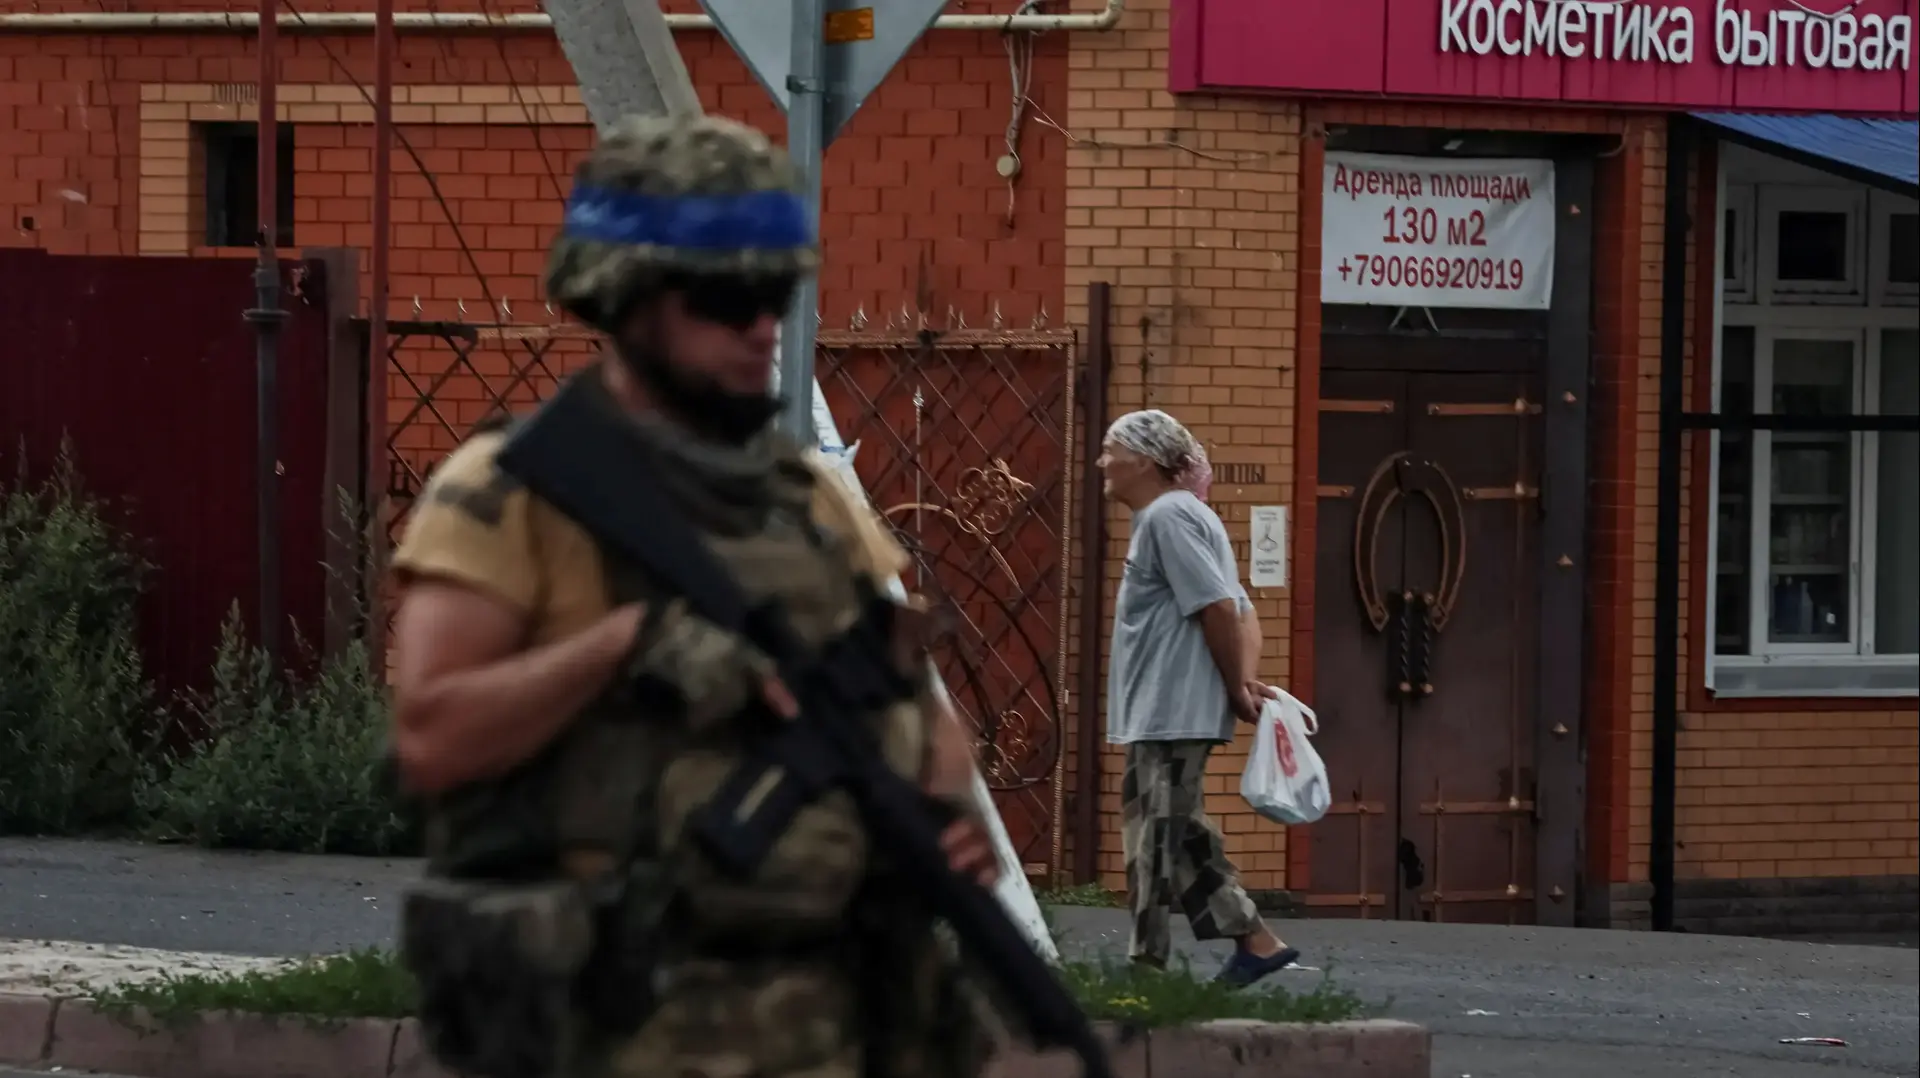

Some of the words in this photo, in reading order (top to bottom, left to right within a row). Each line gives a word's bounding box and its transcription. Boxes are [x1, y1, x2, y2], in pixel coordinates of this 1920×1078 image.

[1715, 0, 1911, 70] бытовая
[1333, 162, 1422, 200] Аренда
[1430, 173, 1531, 204] площади
[1382, 206, 1437, 245] 130
[1447, 209, 1486, 246] м2
[1337, 254, 1523, 290] +79066920919
